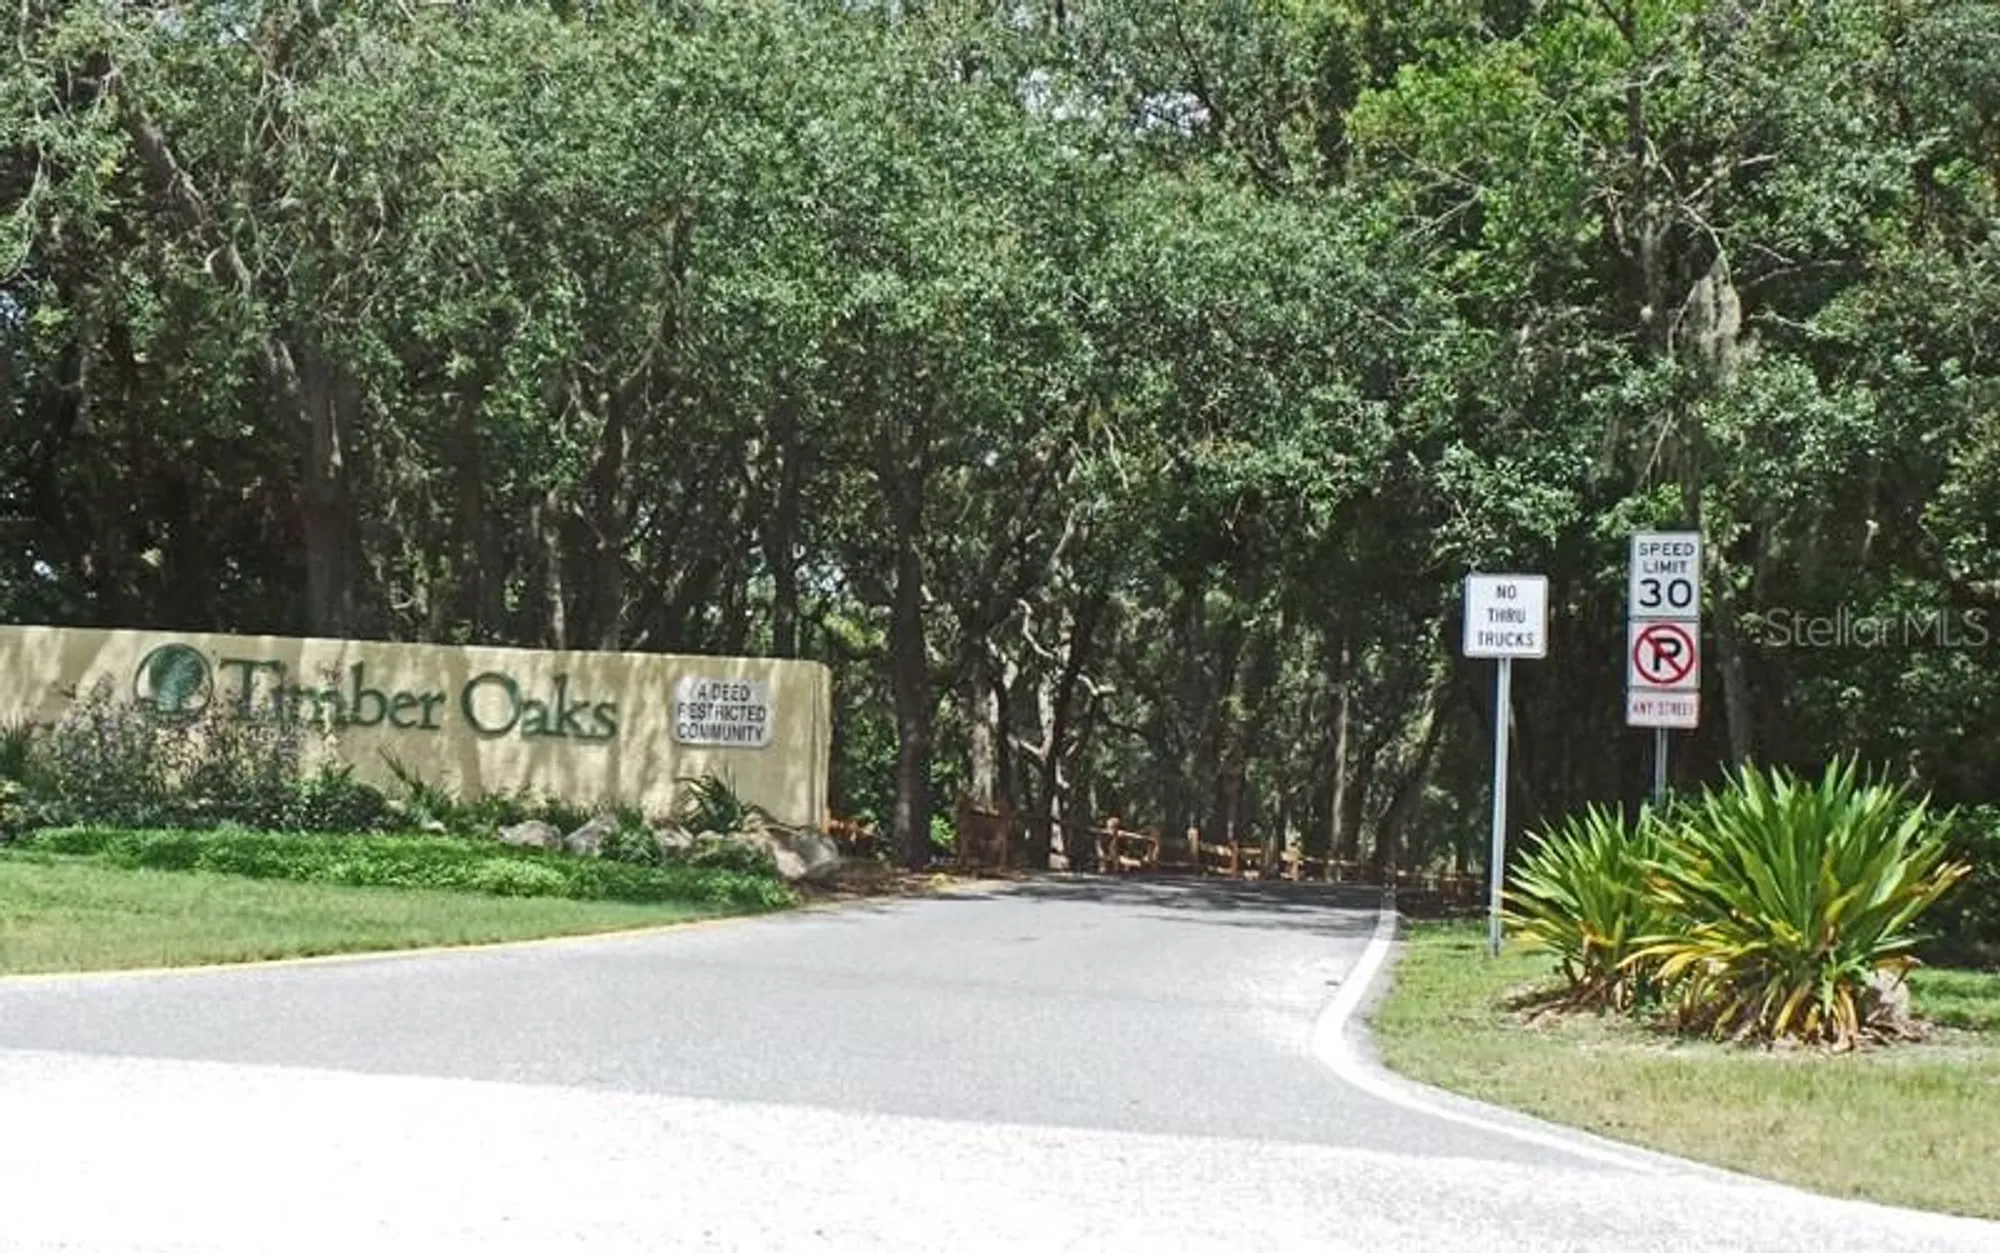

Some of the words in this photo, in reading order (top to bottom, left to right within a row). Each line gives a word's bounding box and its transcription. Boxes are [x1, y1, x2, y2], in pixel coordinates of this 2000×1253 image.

[1639, 542, 1695, 557] SPEED
[1642, 560, 1687, 574] LIMIT
[1496, 584, 1517, 601] NO
[1639, 577, 1693, 609] 30
[1487, 607, 1526, 624] THRU
[1477, 631, 1535, 647] TRUCKS
[219, 656, 447, 732] Timber
[460, 671, 618, 741] Oaks
[711, 682, 752, 702] DEED
[677, 722, 765, 742] COMMUNITY
